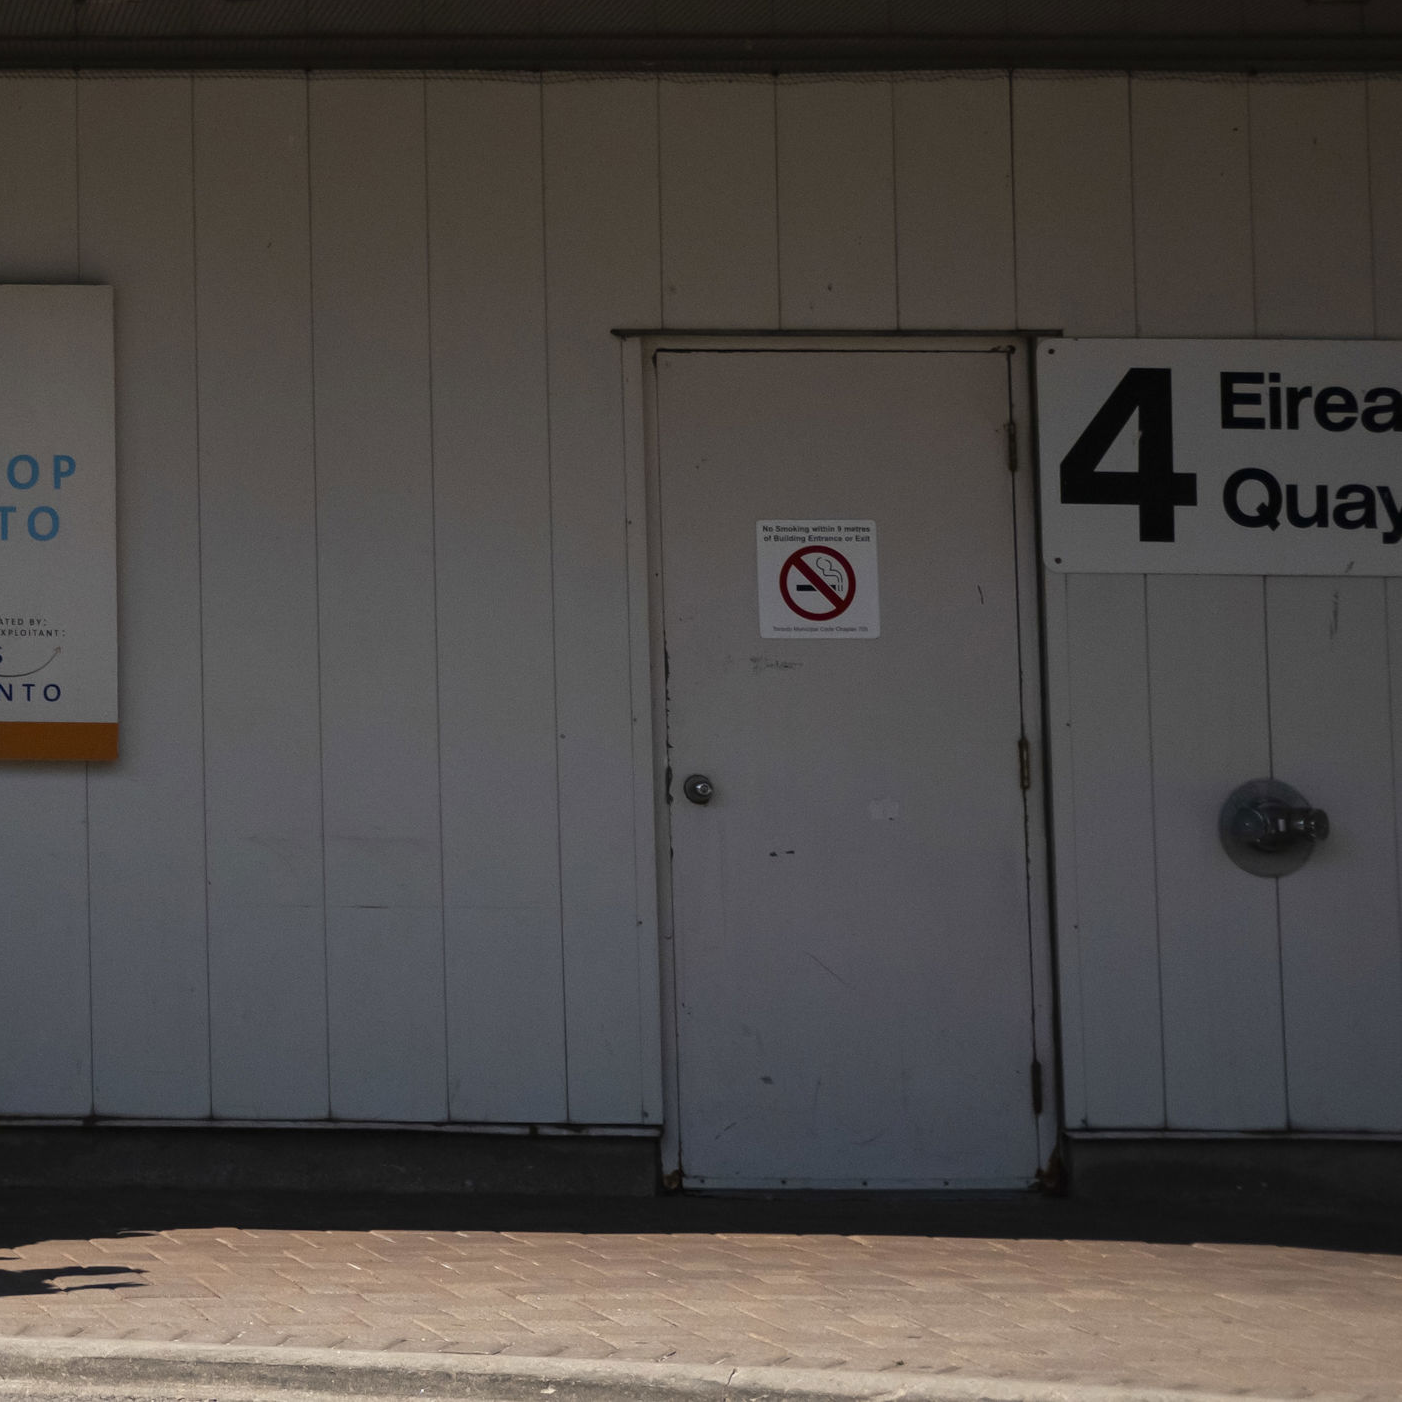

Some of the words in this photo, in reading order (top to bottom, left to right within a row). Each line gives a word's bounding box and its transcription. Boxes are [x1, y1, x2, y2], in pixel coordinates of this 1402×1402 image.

[1060, 367, 1197, 542] 4
[1223, 468, 1402, 544] Quay
[774, 535, 806, 543] Building
[775, 525, 809, 533] Smoking
